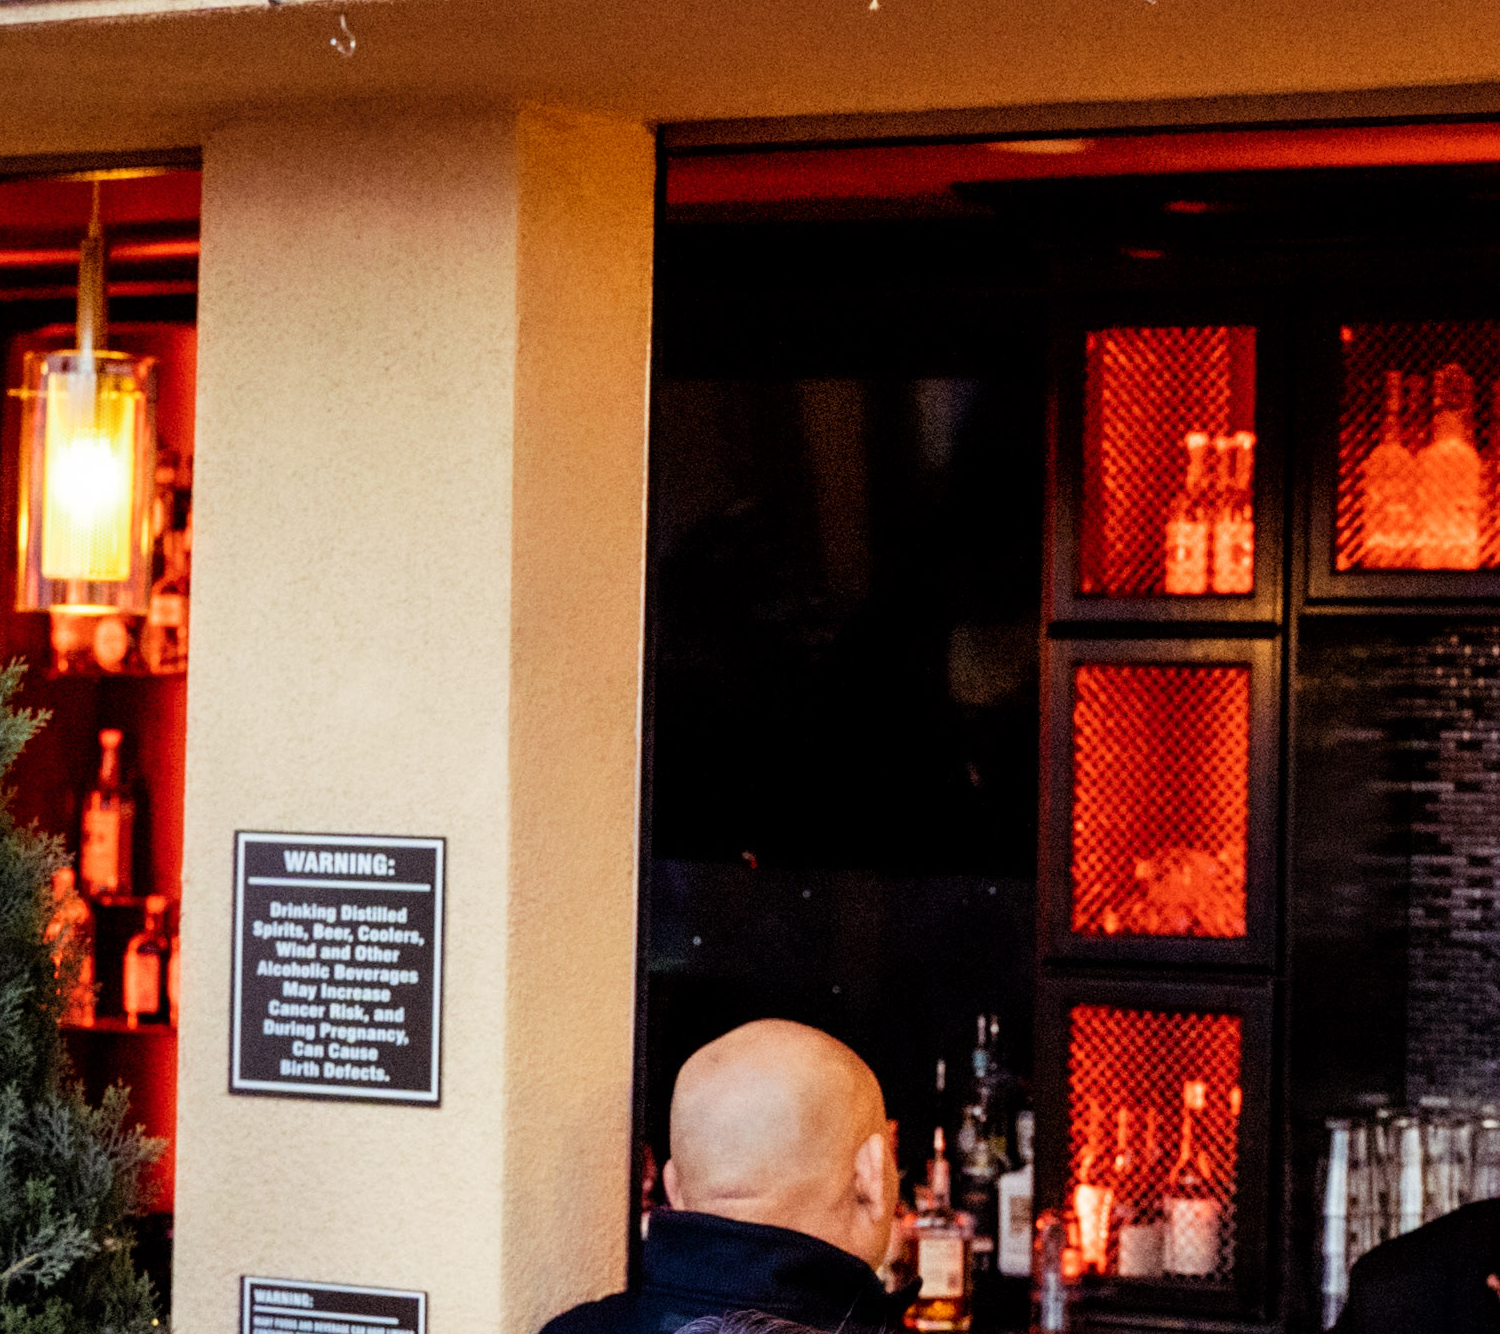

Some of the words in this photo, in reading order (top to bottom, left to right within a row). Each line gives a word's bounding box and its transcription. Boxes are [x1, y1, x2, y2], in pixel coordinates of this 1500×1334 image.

[283, 850, 395, 876] WARNING:
[270, 901, 337, 922] Drinking
[340, 904, 407, 923] Distilled
[252, 920, 309, 941] Spirits,
[313, 921, 354, 943] Beer,
[357, 925, 425, 946] Coolers,
[275, 941, 317, 959] Wind
[320, 944, 351, 961] and
[354, 945, 400, 963] Other
[257, 960, 330, 979] Alcoholic
[334, 964, 419, 985] Beverages
[282, 981, 317, 1001] May
[321, 984, 391, 1002] Increase
[268, 999, 326, 1018] Cancer
[329, 1003, 369, 1023] Risk,
[373, 1007, 405, 1023] and
[263, 1019, 316, 1041] During
[319, 1022, 409, 1045] Pregnancy,
[292, 1040, 324, 1058] Can
[328, 1042, 378, 1061] Cause
[280, 1059, 320, 1077] Birth
[323, 1062, 390, 1082] Defects.
[254, 1289, 313, 1306] WARNING:
